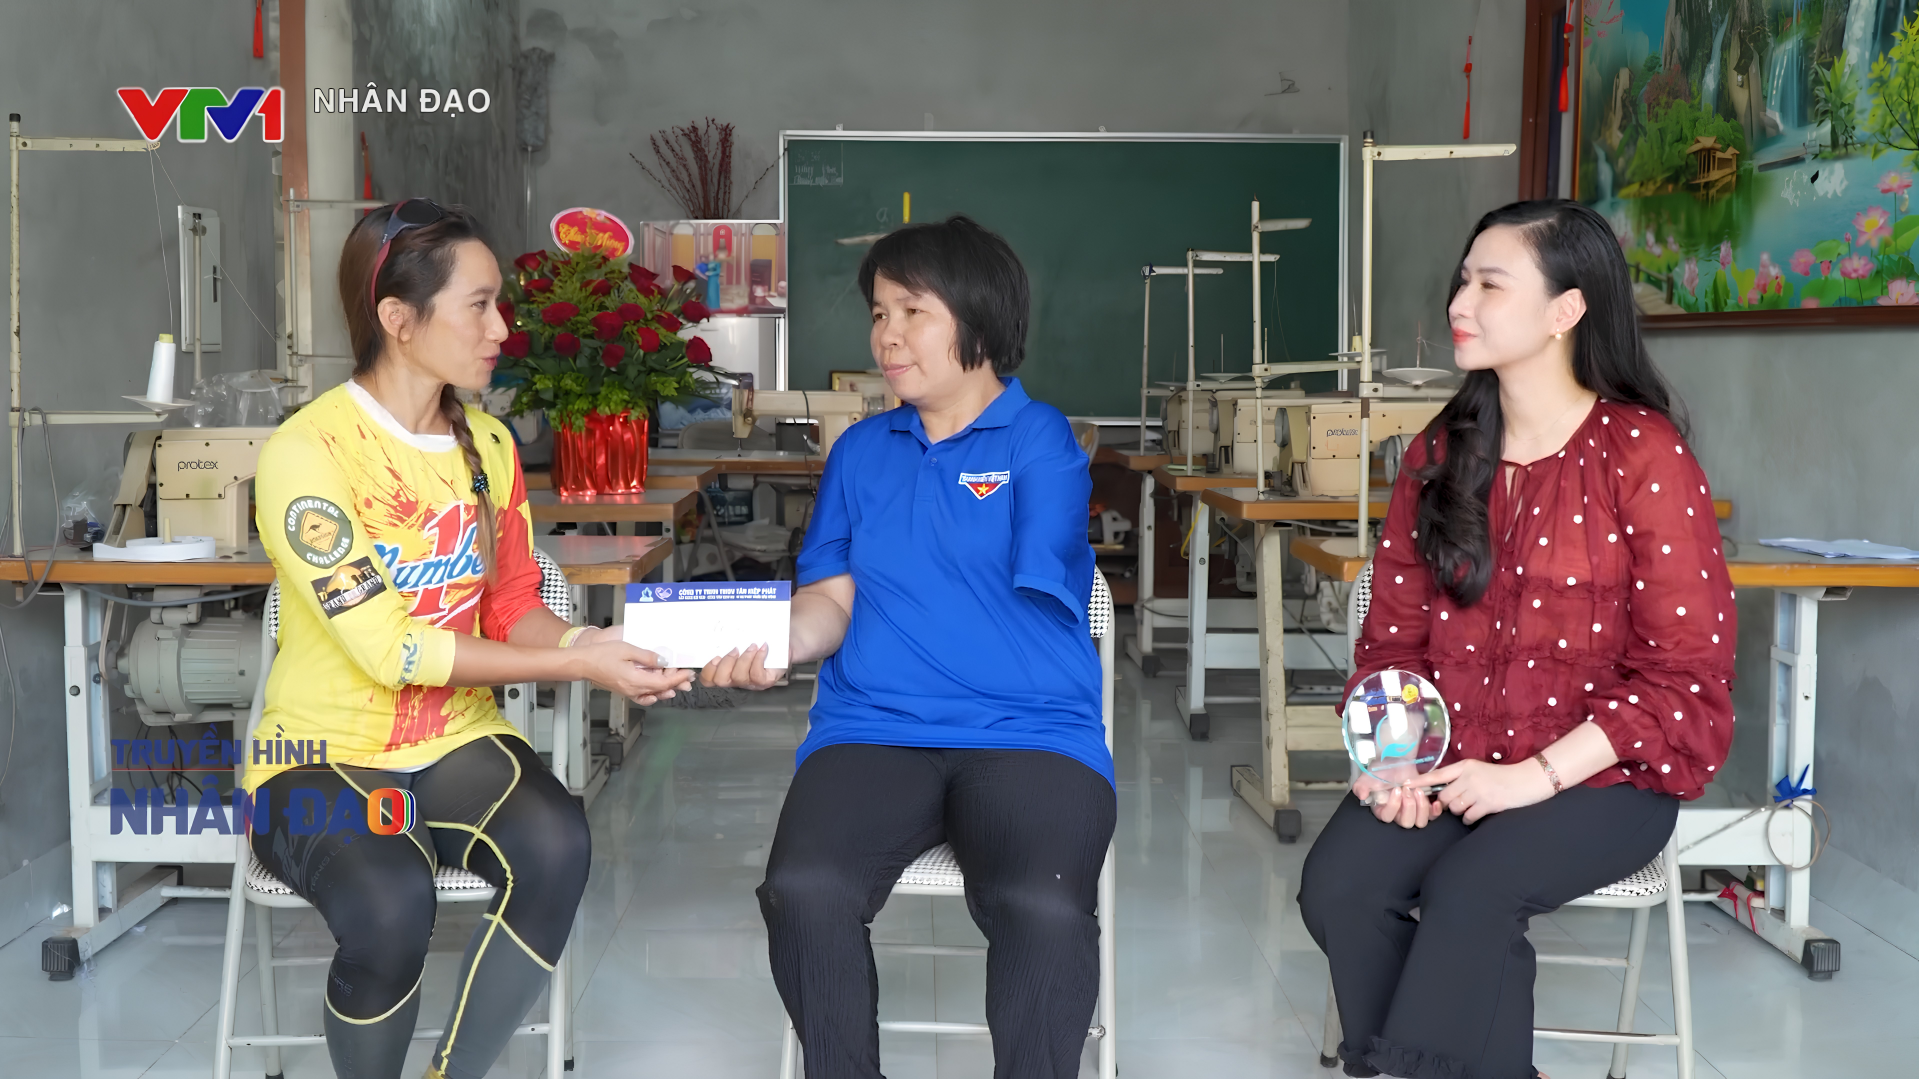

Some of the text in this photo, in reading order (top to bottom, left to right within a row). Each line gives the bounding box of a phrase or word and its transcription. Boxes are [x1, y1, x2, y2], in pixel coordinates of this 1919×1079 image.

[177, 459, 219, 472] protex
[287, 499, 340, 532] CONTINENTAL
[407, 499, 464, 618] 1
